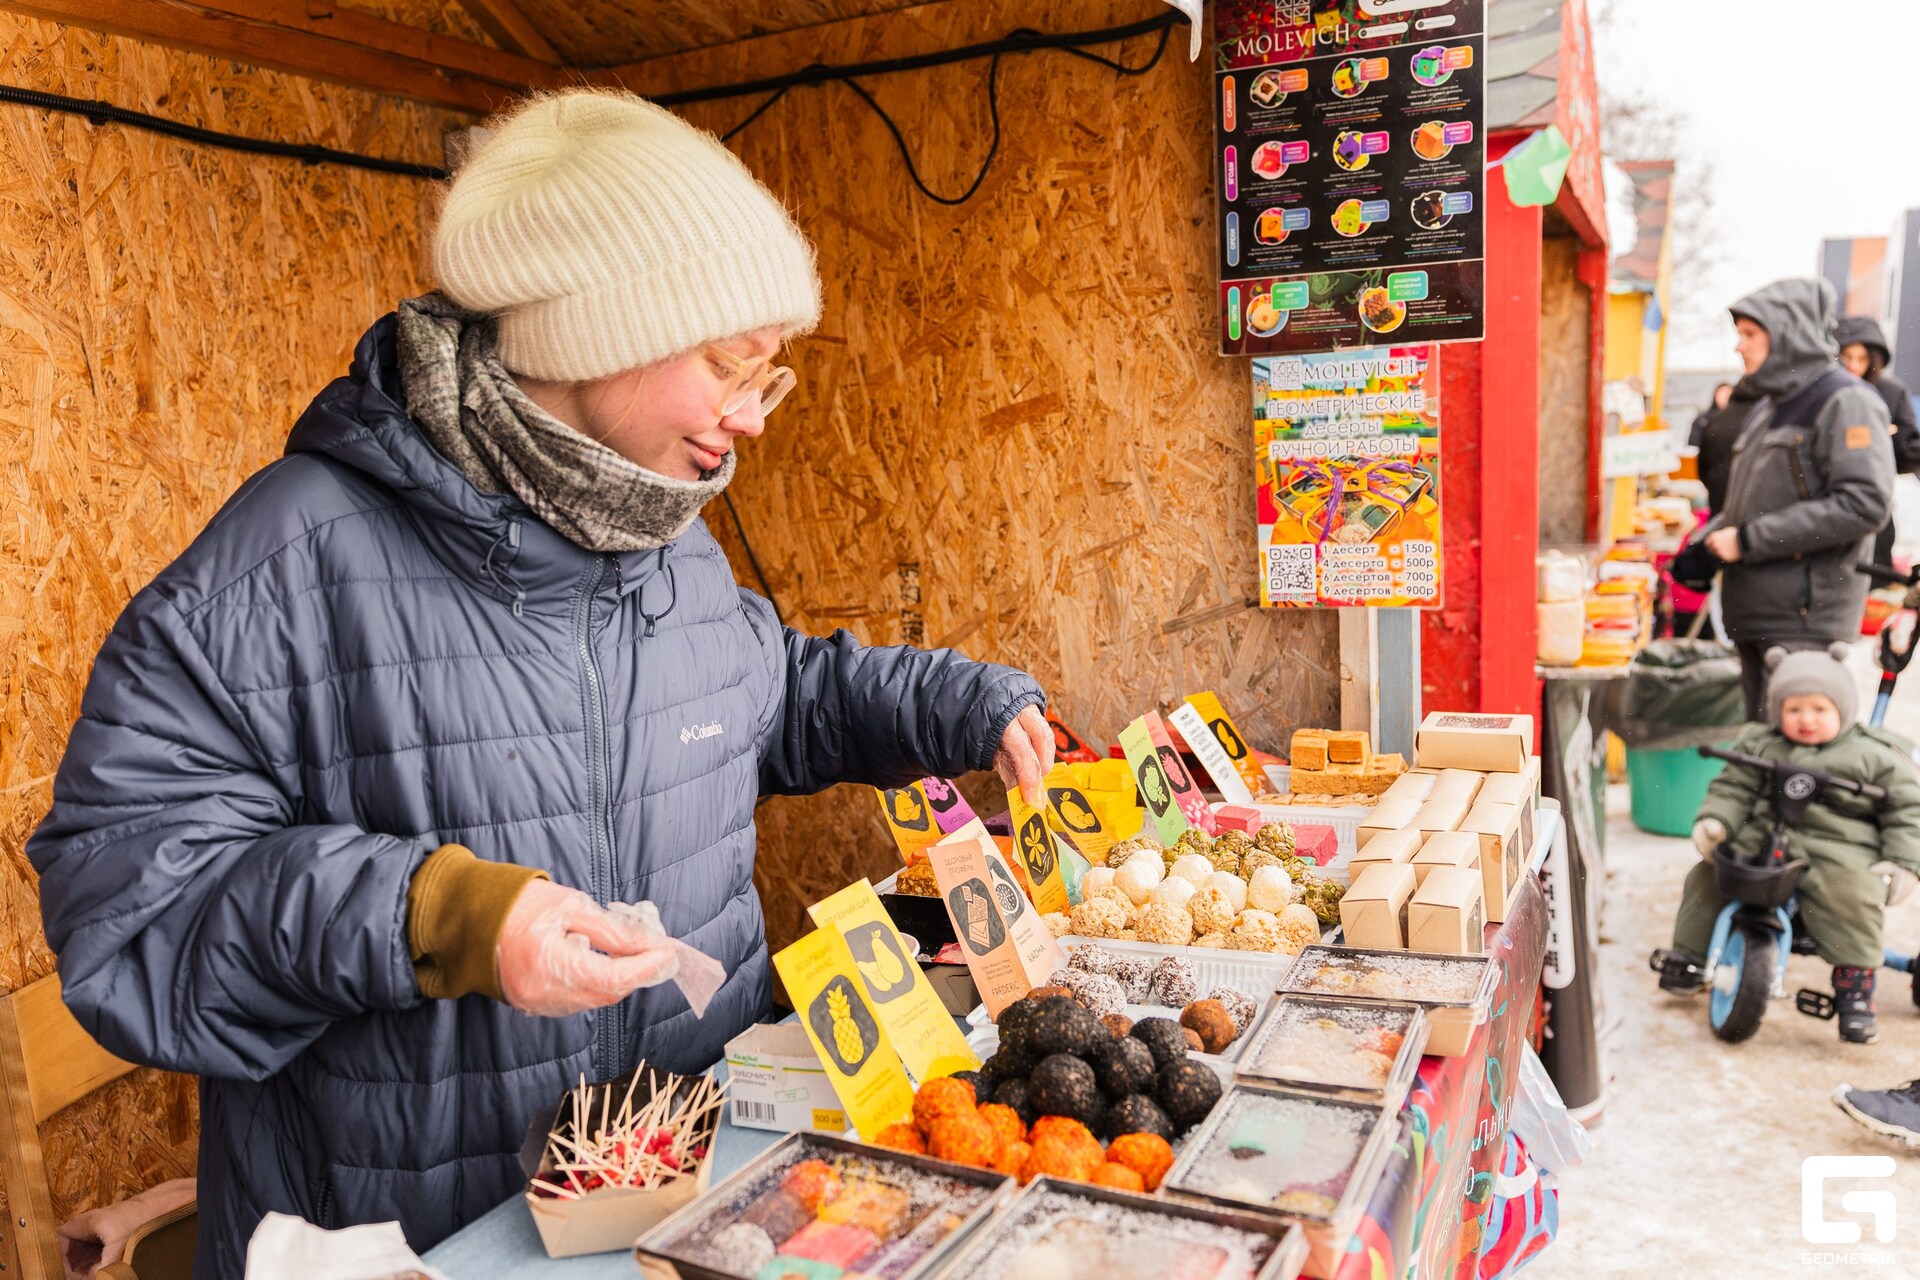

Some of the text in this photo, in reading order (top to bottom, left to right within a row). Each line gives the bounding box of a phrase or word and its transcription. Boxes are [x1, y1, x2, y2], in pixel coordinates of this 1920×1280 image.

[1237, 23, 1349, 58] MOLEVICH
[1228, 160, 1236, 183] ЯГОДЫ
[1304, 359, 1414, 381] MOLEVICH
[1268, 394, 1423, 417] ГЕОМЕТРИЧЕСКИЕ
[1305, 421, 1379, 437] десерты
[1272, 438, 1416, 457] РУЧНОЙ РАБОТЫ
[1323, 546, 1328, 554] 1
[1332, 545, 1376, 556] десерт
[1404, 544, 1433, 555] 150р
[1323, 560, 1330, 568] 4
[1333, 559, 1384, 570] десерта
[1406, 558, 1434, 570] 500р
[1323, 573, 1330, 582] 6
[1333, 573, 1391, 584] десертов
[1406, 572, 1434, 583] 700р
[1324, 587, 1330, 595] 9
[1333, 587, 1391, 598] десертов
[1406, 586, 1434, 598] 900р
[691, 719, 724, 741] Columbia
[948, 865, 975, 876] ТРЮФЕЛЬ
[1027, 944, 1047, 962] RADHA
[733, 1069, 777, 1081] ЗУБОЧИСТК
[814, 1113, 830, 1124] 500
